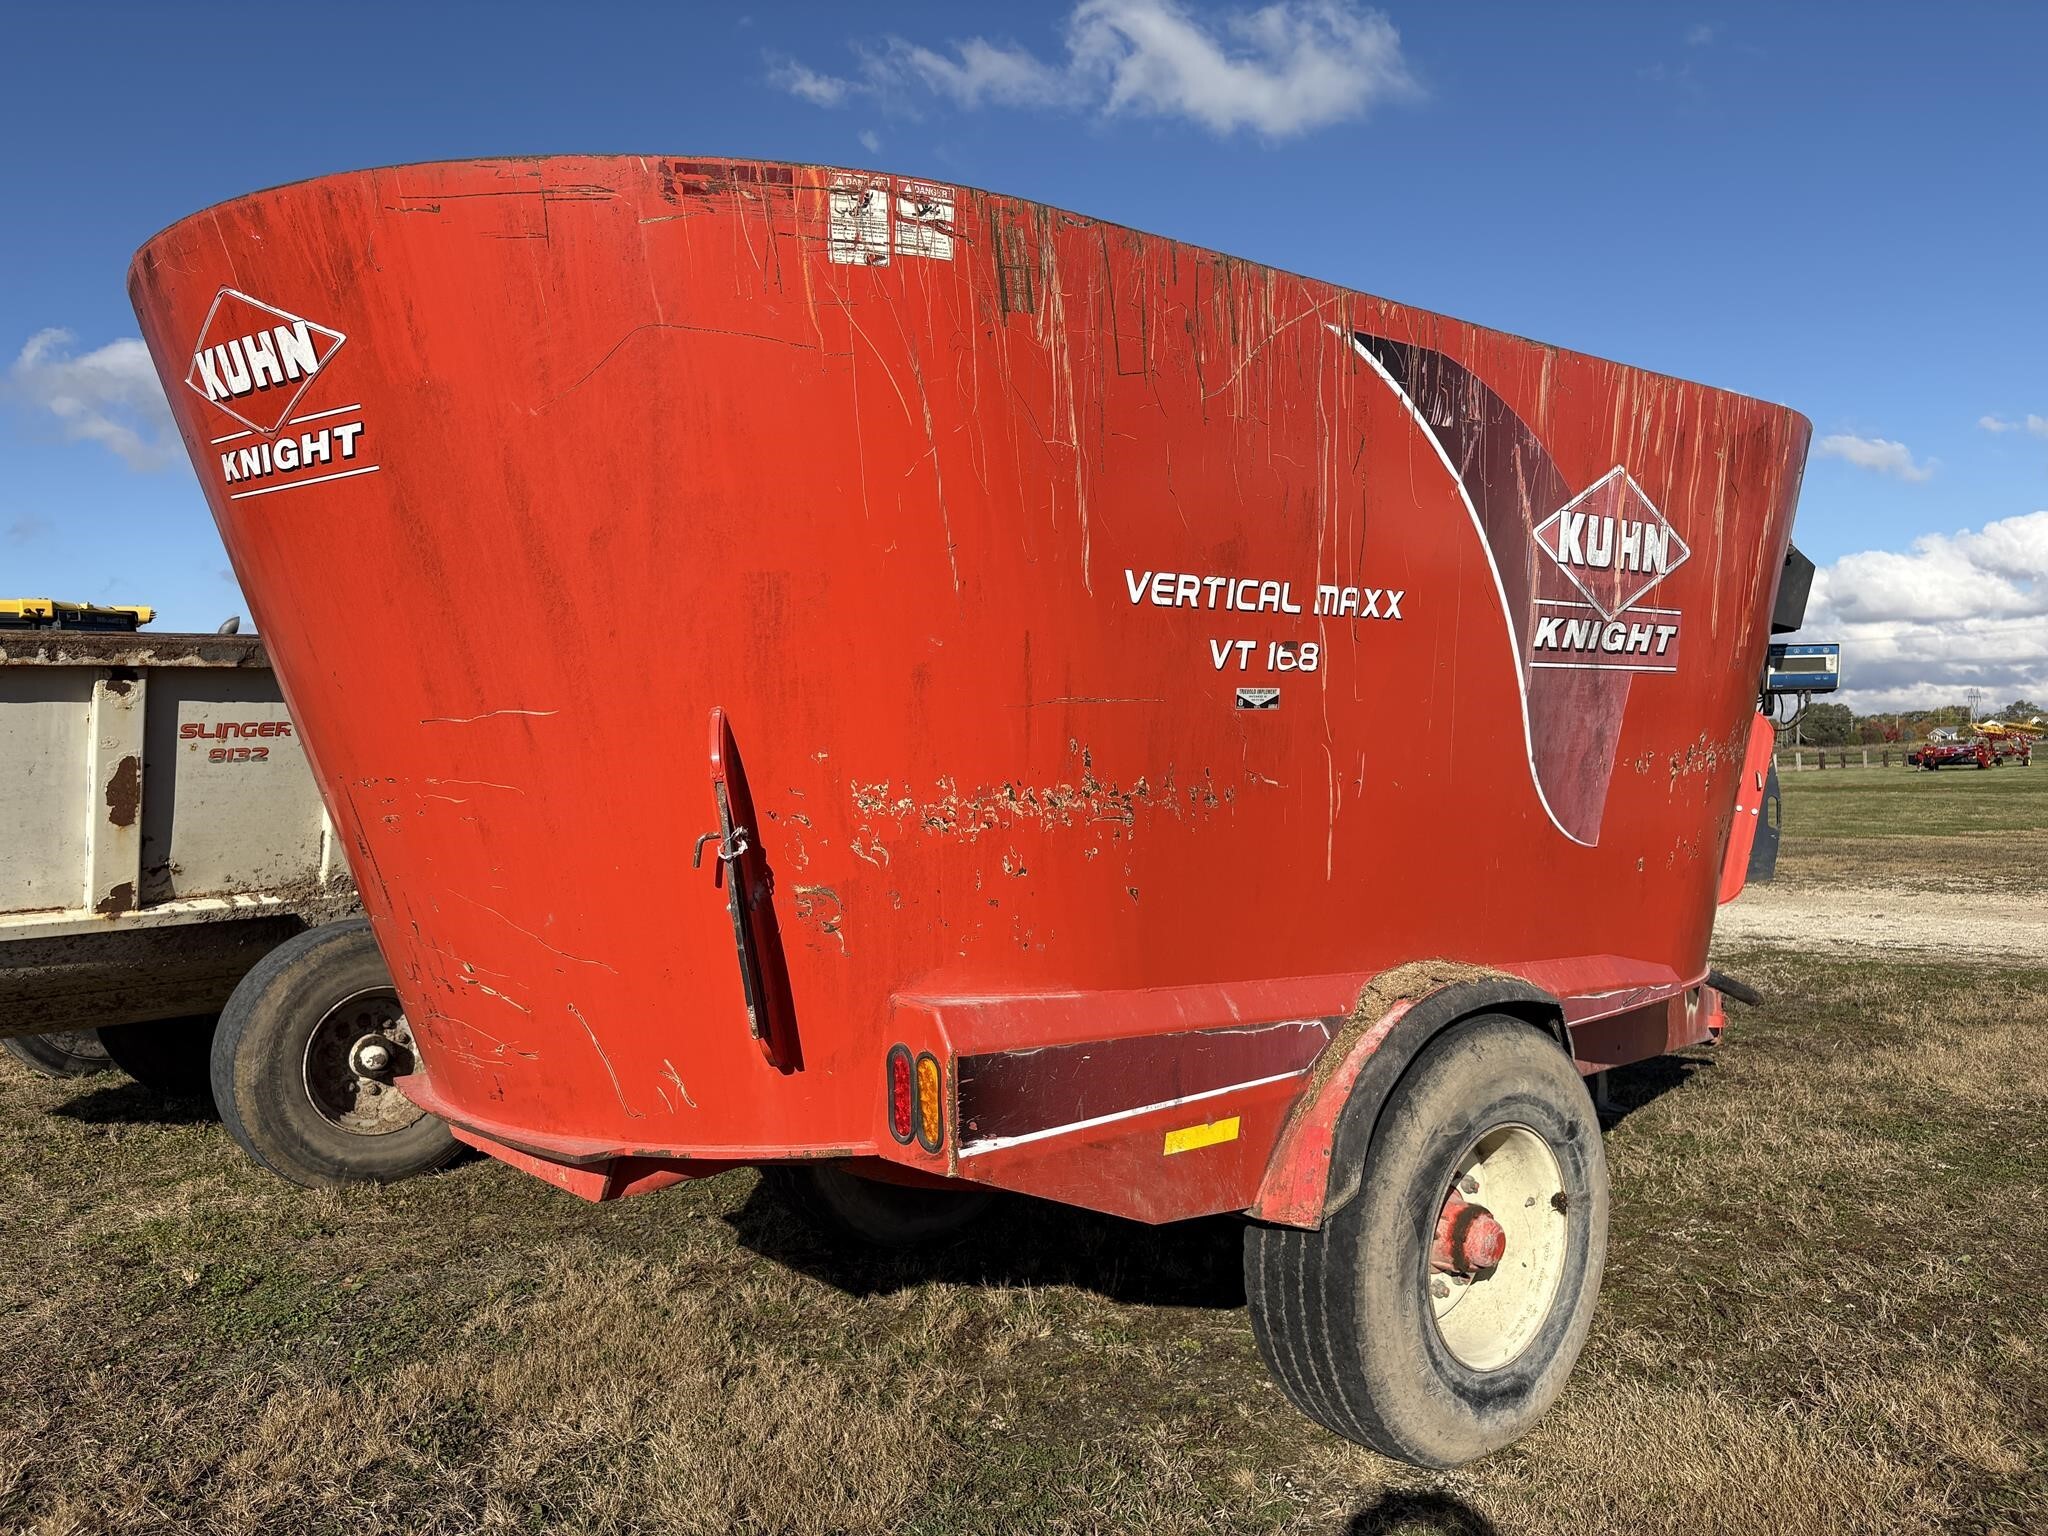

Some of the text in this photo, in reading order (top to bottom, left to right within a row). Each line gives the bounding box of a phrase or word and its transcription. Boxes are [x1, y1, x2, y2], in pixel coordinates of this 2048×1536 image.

[195, 320, 319, 401] KUHN
[221, 421, 364, 483] KNIGHT
[1557, 510, 1669, 574] KUHN
[1124, 569, 1405, 619] VERTICAL MAXX
[1209, 639, 1319, 672] VT 168
[1533, 617, 1677, 655] KNIGHT
[180, 722, 291, 739] SLINGER
[208, 747, 269, 764] 8132
